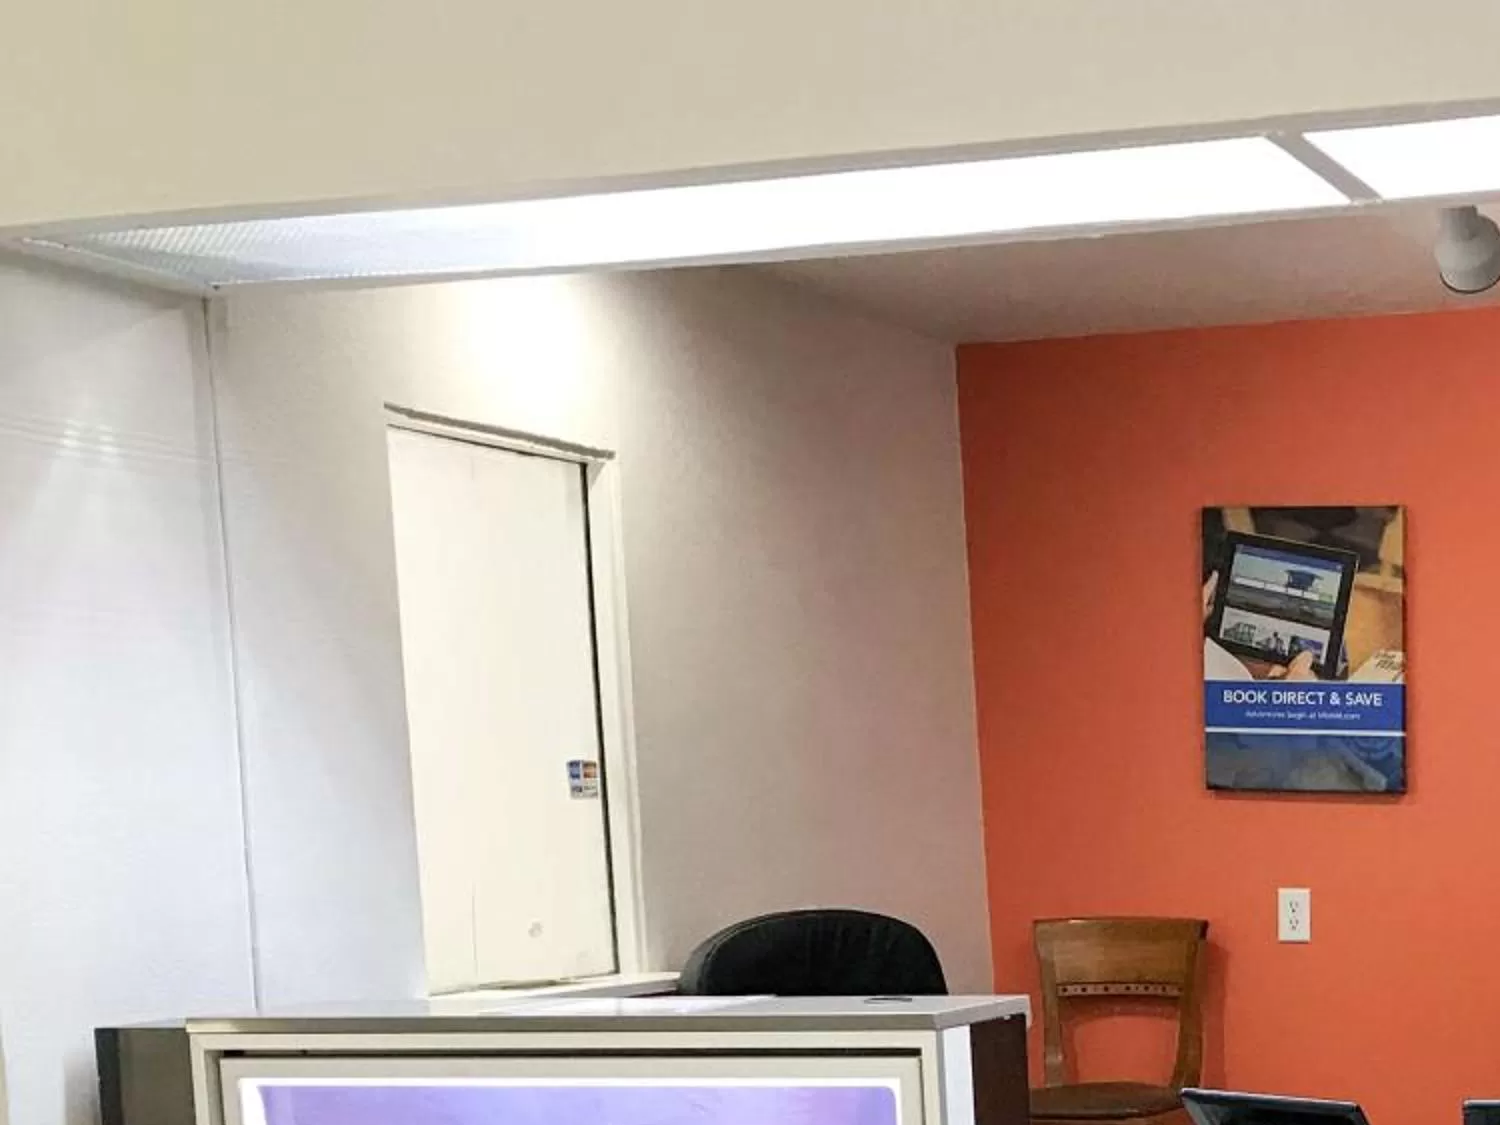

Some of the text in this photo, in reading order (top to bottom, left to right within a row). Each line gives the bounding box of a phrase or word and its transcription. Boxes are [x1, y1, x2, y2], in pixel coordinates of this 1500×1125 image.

[1223, 689, 1384, 707] BOOK DIRECT & SAVE
